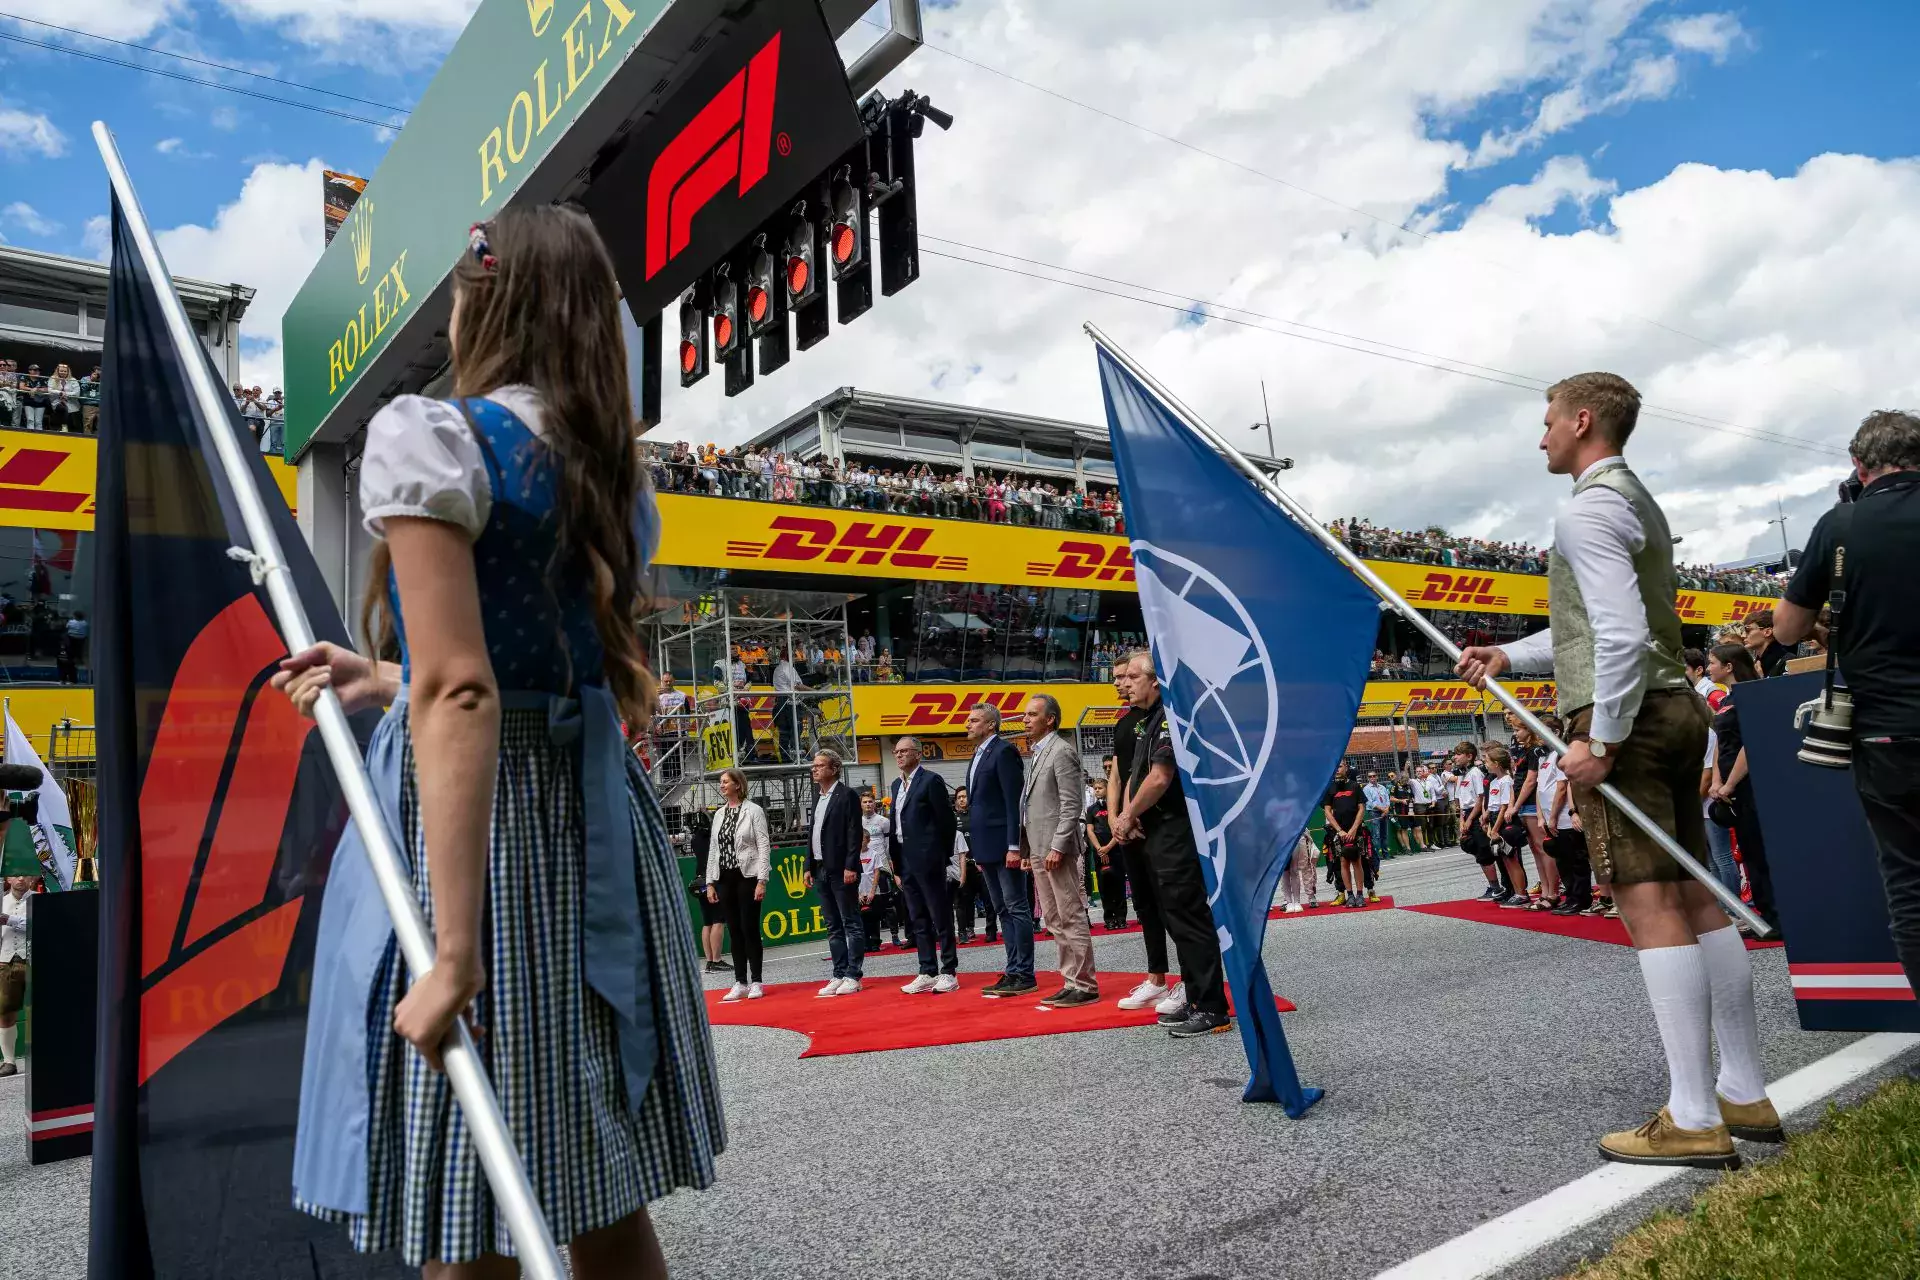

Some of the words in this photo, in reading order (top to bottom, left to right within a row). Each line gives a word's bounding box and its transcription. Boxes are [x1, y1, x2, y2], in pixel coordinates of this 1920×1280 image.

[328, 248, 411, 395] ROLEX
[763, 515, 935, 569] DHL
[1051, 541, 1137, 582] DH
[1835, 545, 1846, 577] Canon
[1421, 573, 1496, 605] DHL
[1408, 687, 1469, 711] DHL
[922, 743, 937, 758] 81
